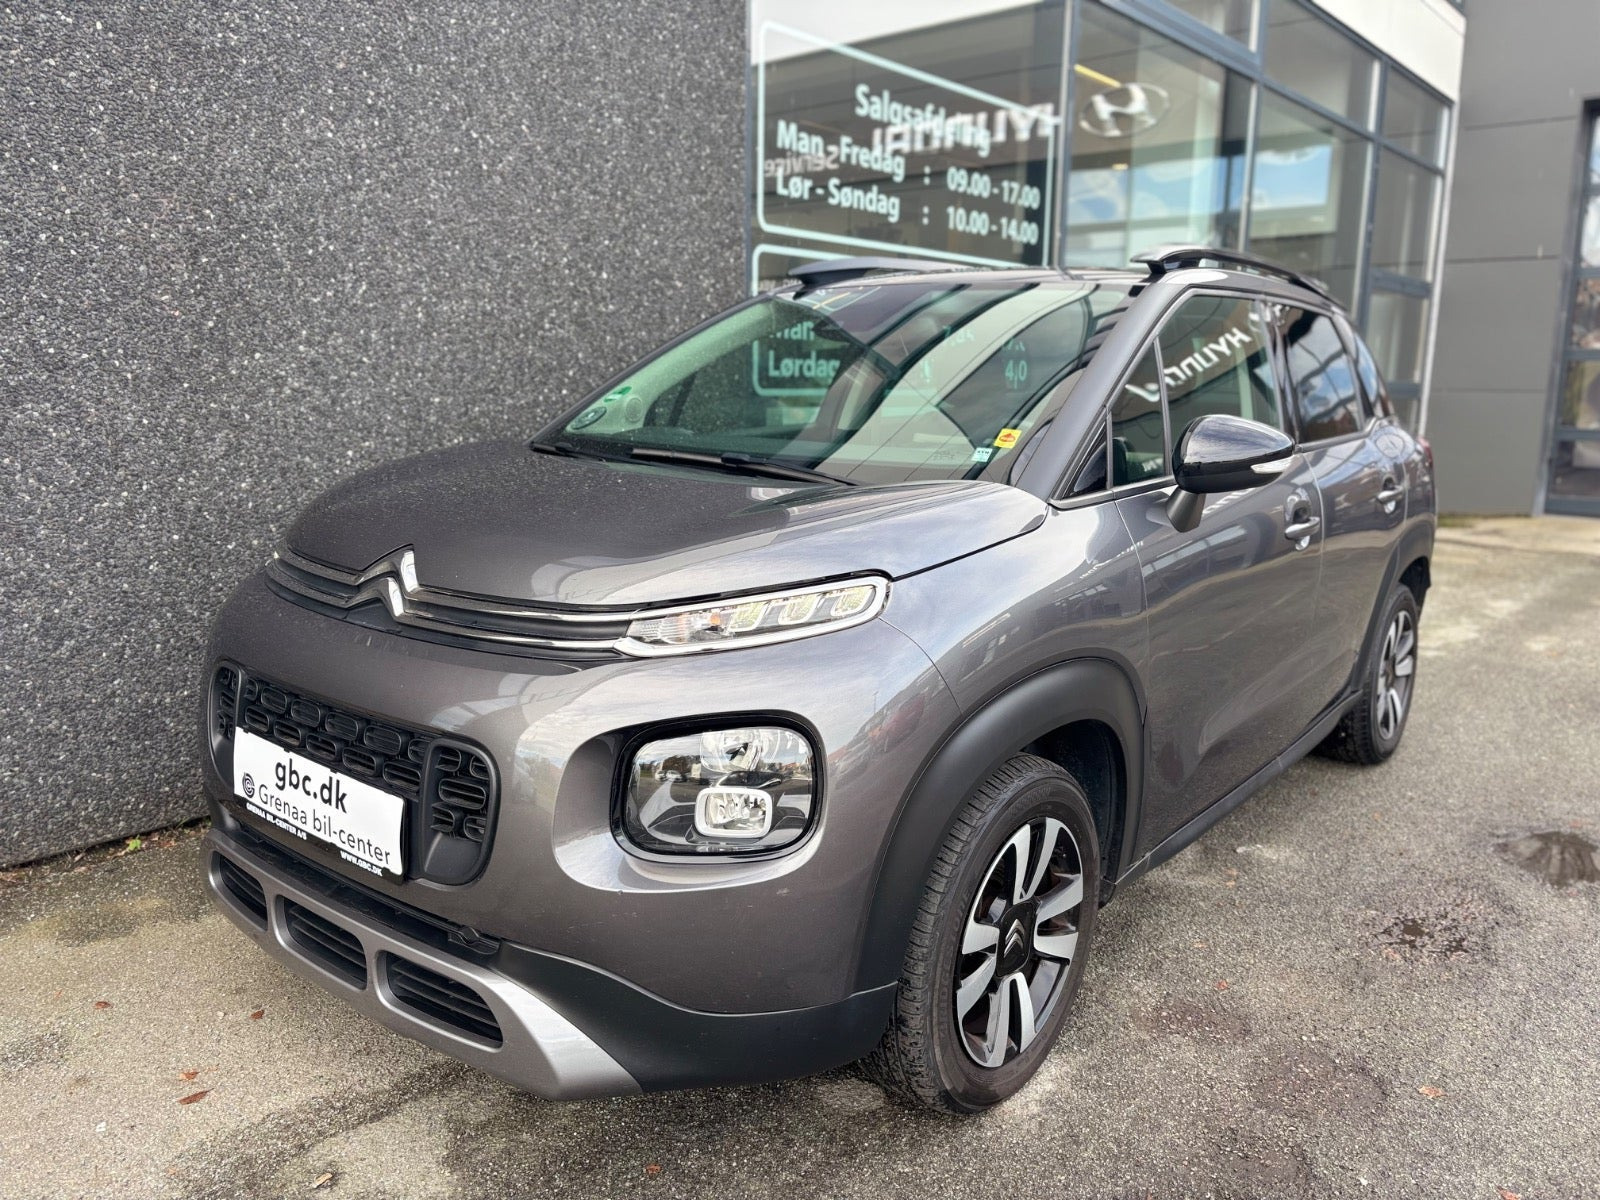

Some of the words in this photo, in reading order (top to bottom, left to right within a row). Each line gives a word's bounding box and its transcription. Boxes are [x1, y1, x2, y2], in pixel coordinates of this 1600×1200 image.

[777, 119, 825, 155] Man
[840, 135, 905, 183] Fredag
[946, 166, 991, 199] 09.00
[1001, 179, 1041, 210] 17.00
[776, 166, 813, 200] Lør
[827, 177, 901, 223] Søndag
[946, 205, 990, 236] 10.00
[1000, 216, 1039, 245] 14.00
[259, 784, 307, 826] Grenaa
[313, 809, 390, 864] bil-center
[275, 758, 348, 813] gbc.dk
